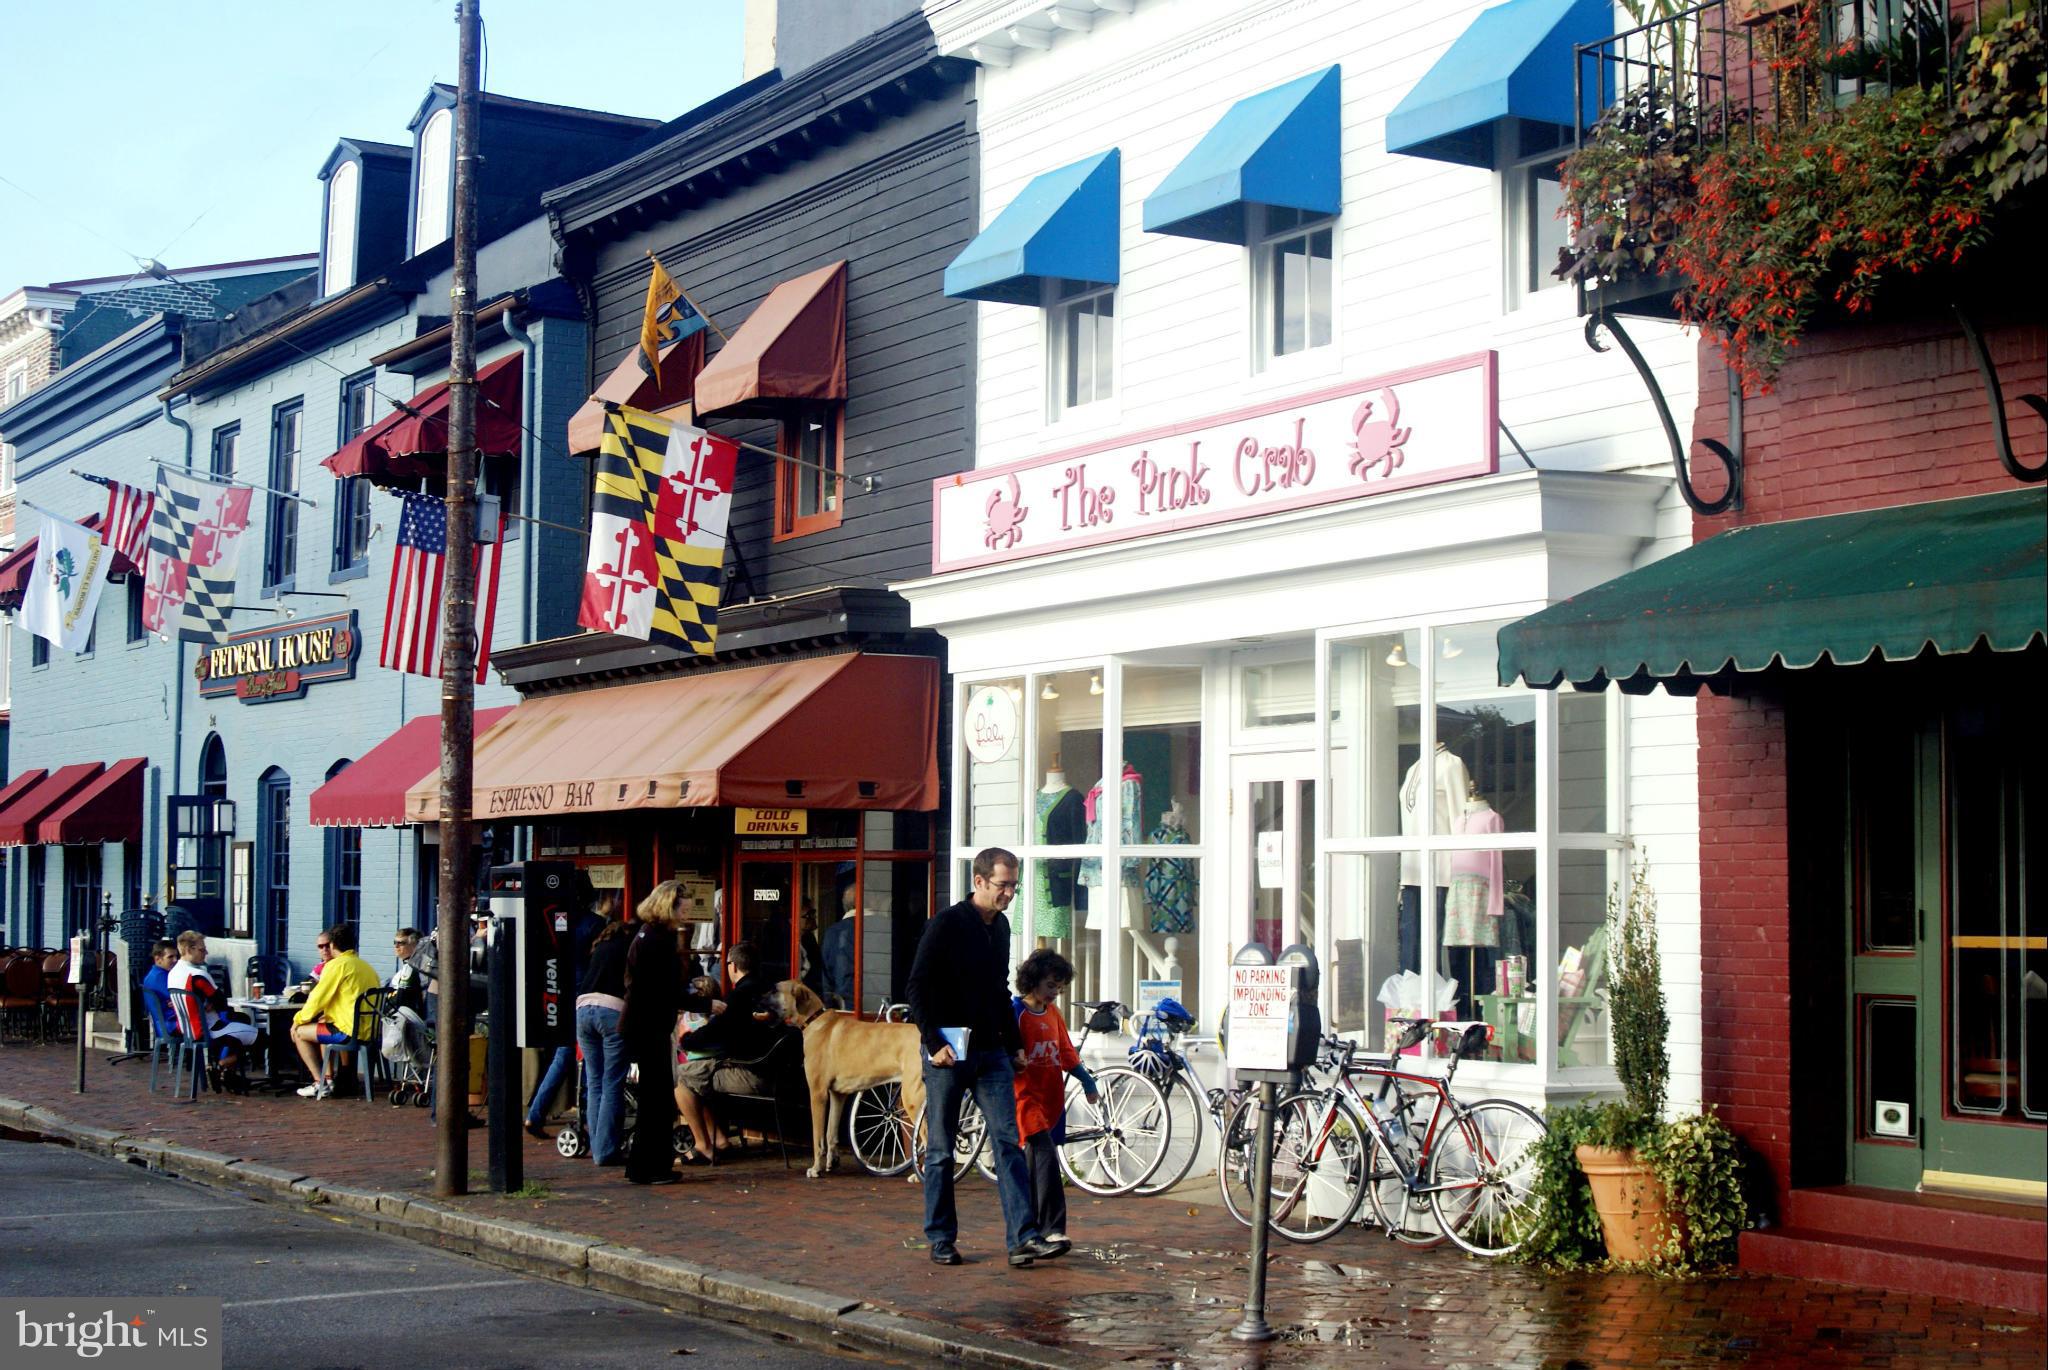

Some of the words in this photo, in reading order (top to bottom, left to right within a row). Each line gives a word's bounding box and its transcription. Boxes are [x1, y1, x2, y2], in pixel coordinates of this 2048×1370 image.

[1052, 464, 1116, 531] The
[1131, 440, 1210, 516] Pink
[1233, 417, 1317, 497] Crab
[210, 638, 275, 679] FEDERAL
[278, 627, 334, 669] HOUSE
[489, 784, 554, 814] ESPRESSO
[563, 781, 595, 807] BAR
[755, 810, 791, 820] COLD
[746, 821, 800, 832] DRINKS
[754, 889, 780, 901] ESPRESSO
[1235, 969, 1247, 984] NO
[1251, 969, 1286, 984] PARKING
[543, 958, 561, 1027] verizon
[1234, 987, 1287, 1002] IMPOUNDING
[1248, 1002, 1269, 1017] ZONE
